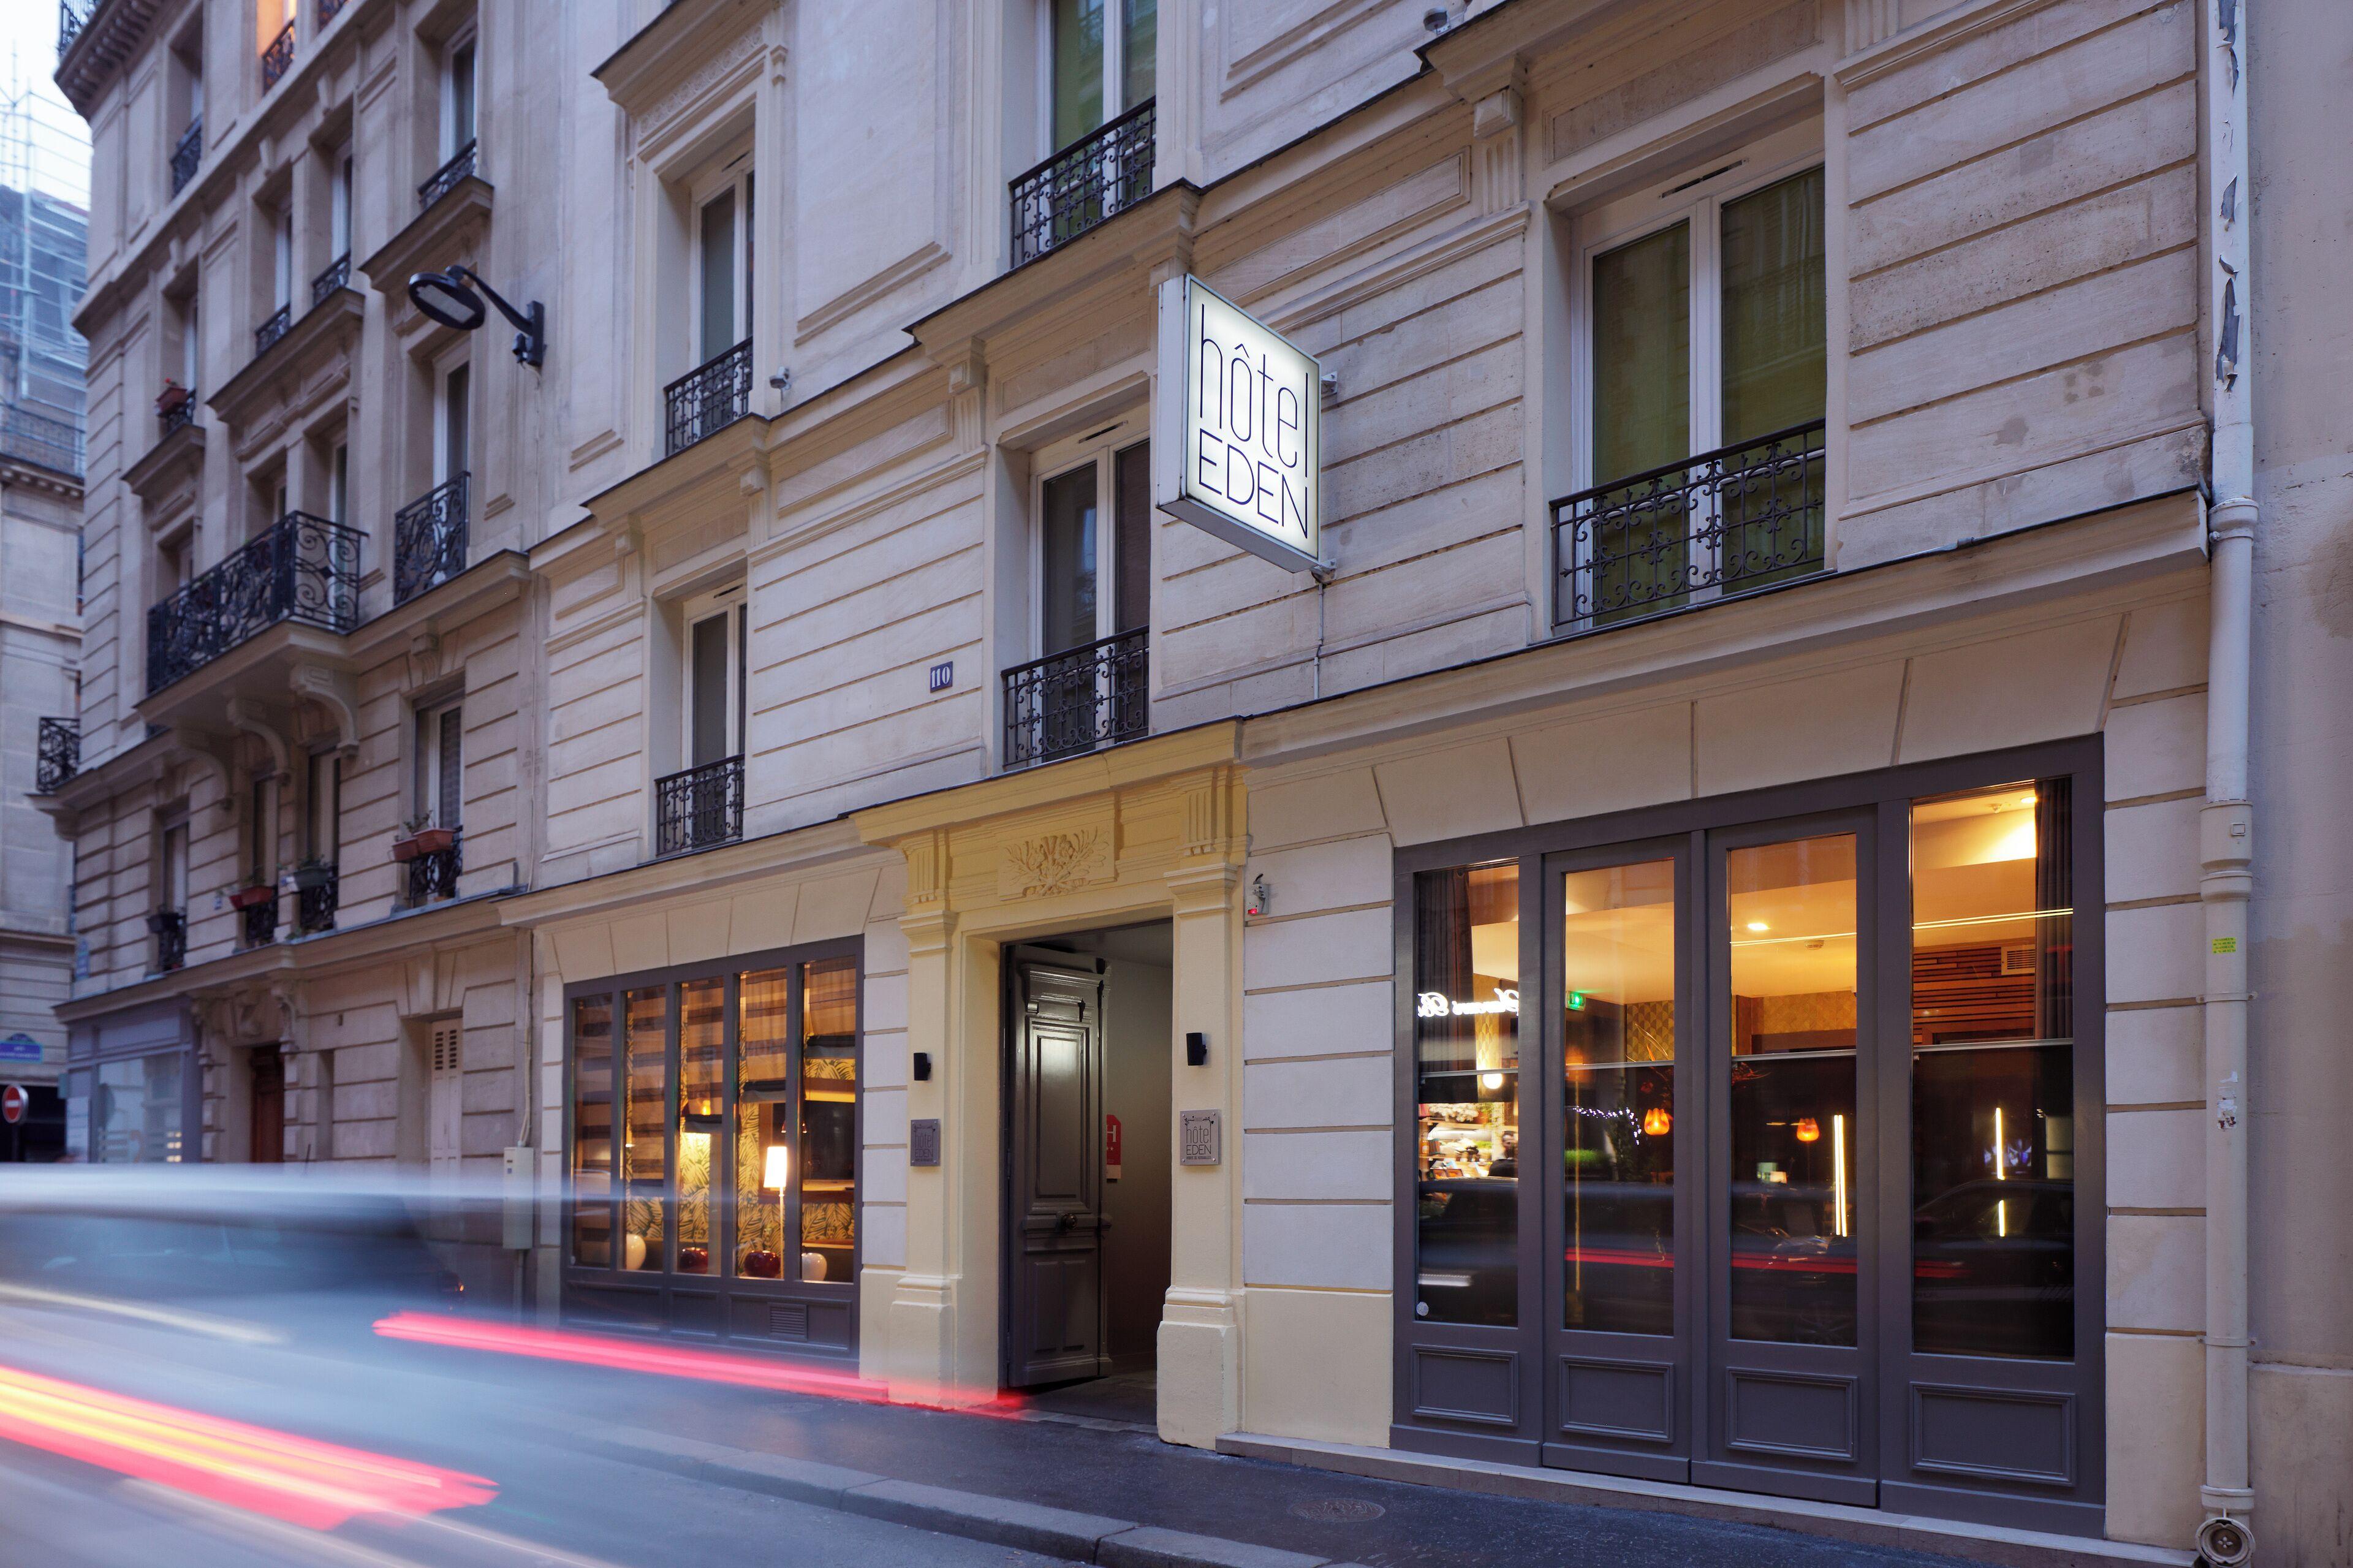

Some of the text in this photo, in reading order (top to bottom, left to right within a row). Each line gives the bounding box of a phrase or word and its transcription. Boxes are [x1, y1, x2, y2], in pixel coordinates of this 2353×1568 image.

[1199, 303, 1309, 478] hôtel
[1199, 428, 1308, 539] EDEN
[931, 666, 950, 688] 110
[1186, 1123, 1211, 1144] hôtel
[1186, 1144, 1211, 1156] EDEN
